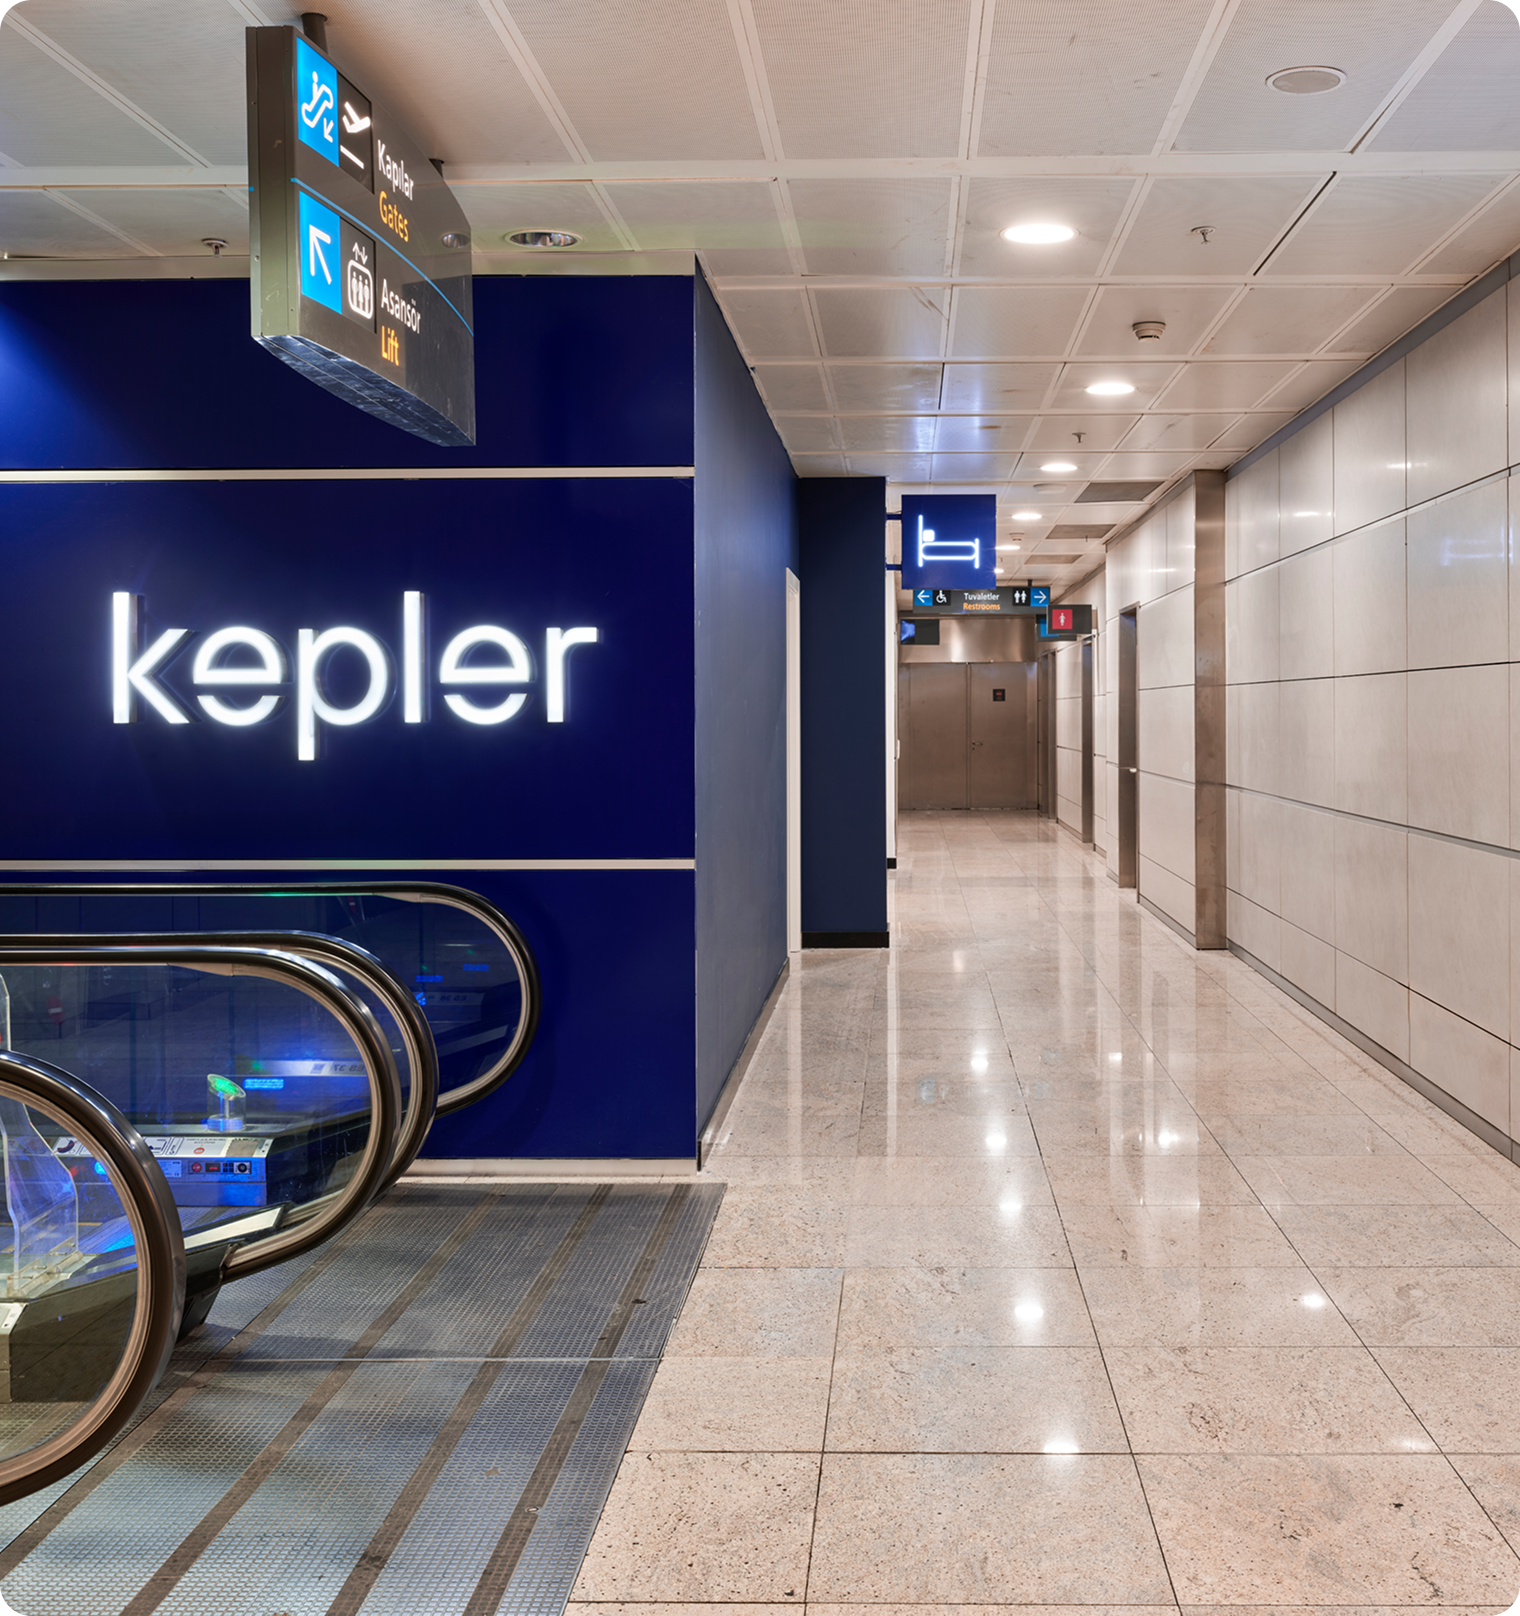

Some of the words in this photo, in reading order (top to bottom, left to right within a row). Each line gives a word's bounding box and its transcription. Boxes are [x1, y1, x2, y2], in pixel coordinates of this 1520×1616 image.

[377, 139, 414, 201] Kapılar
[379, 190, 409, 242] Gates
[381, 278, 421, 334] Asansör
[381, 325, 400, 366] Lift
[962, 602, 1001, 611] Restrooms
[963, 592, 1000, 601] Tuvaletler
[112, 590, 598, 761] kepler
